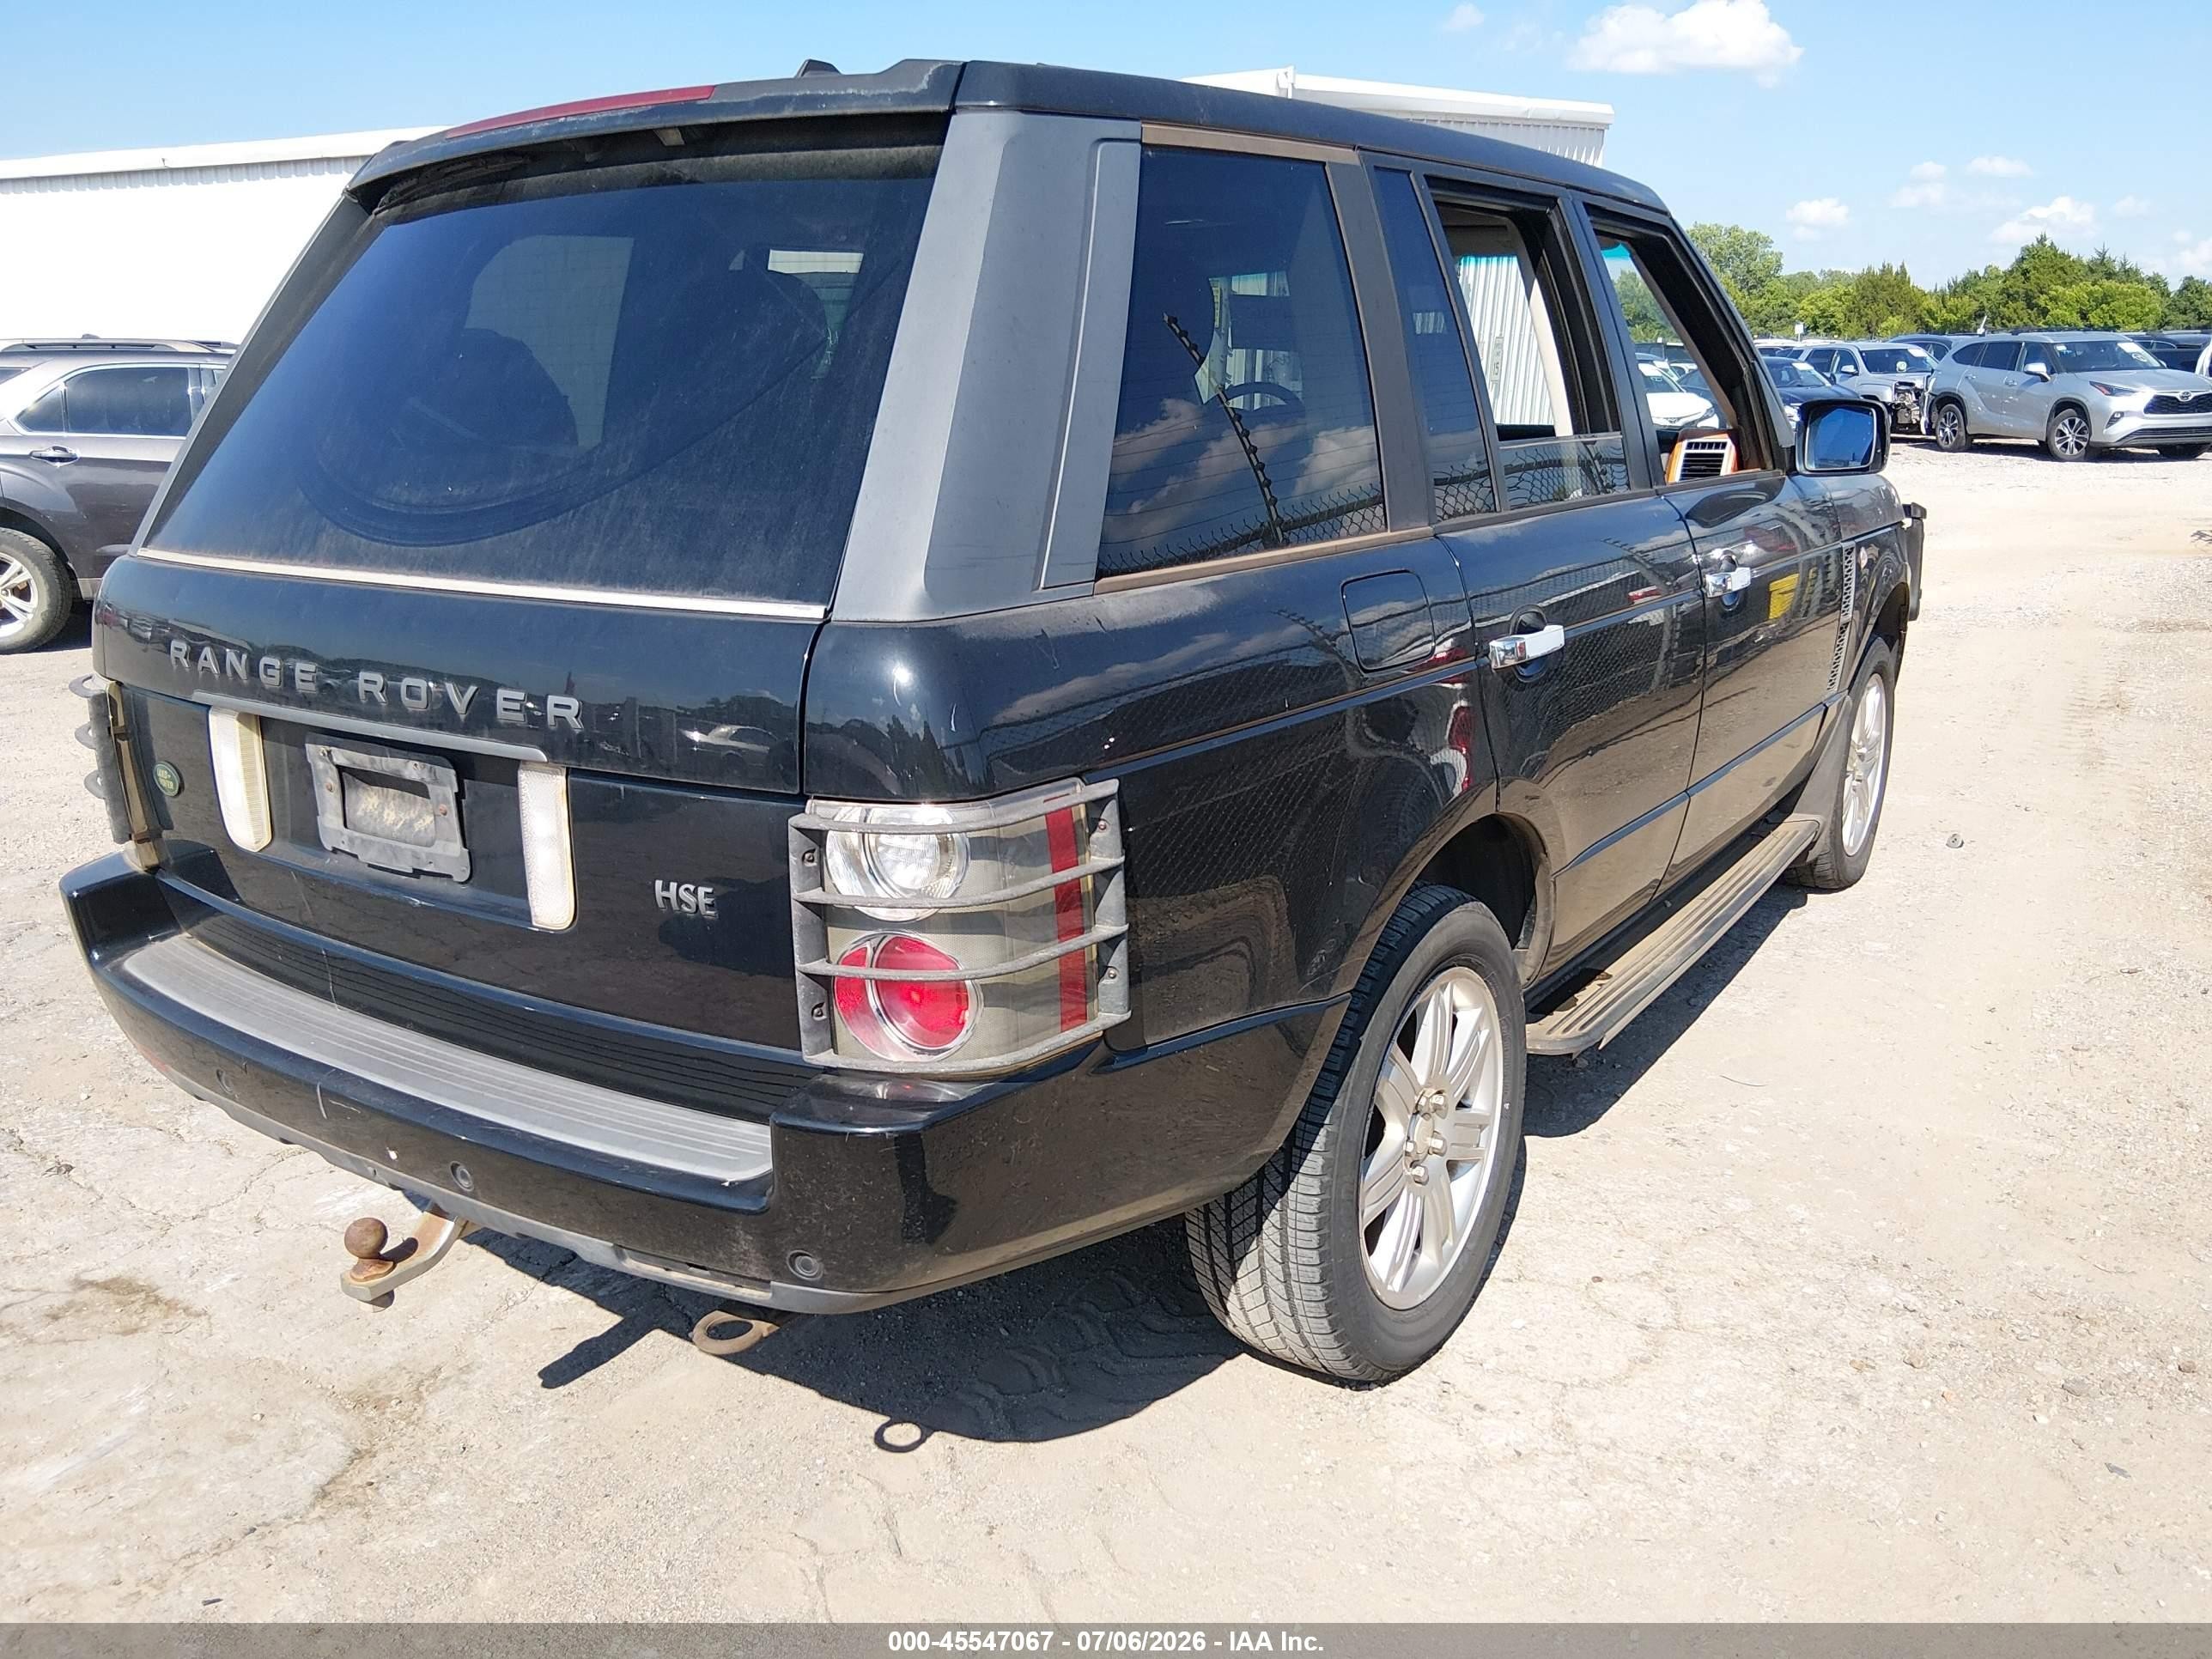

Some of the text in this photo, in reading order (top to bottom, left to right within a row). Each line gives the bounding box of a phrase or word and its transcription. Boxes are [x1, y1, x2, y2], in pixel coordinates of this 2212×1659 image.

[169, 639, 586, 730] RANGE ROVER
[654, 879, 716, 918] HSE
